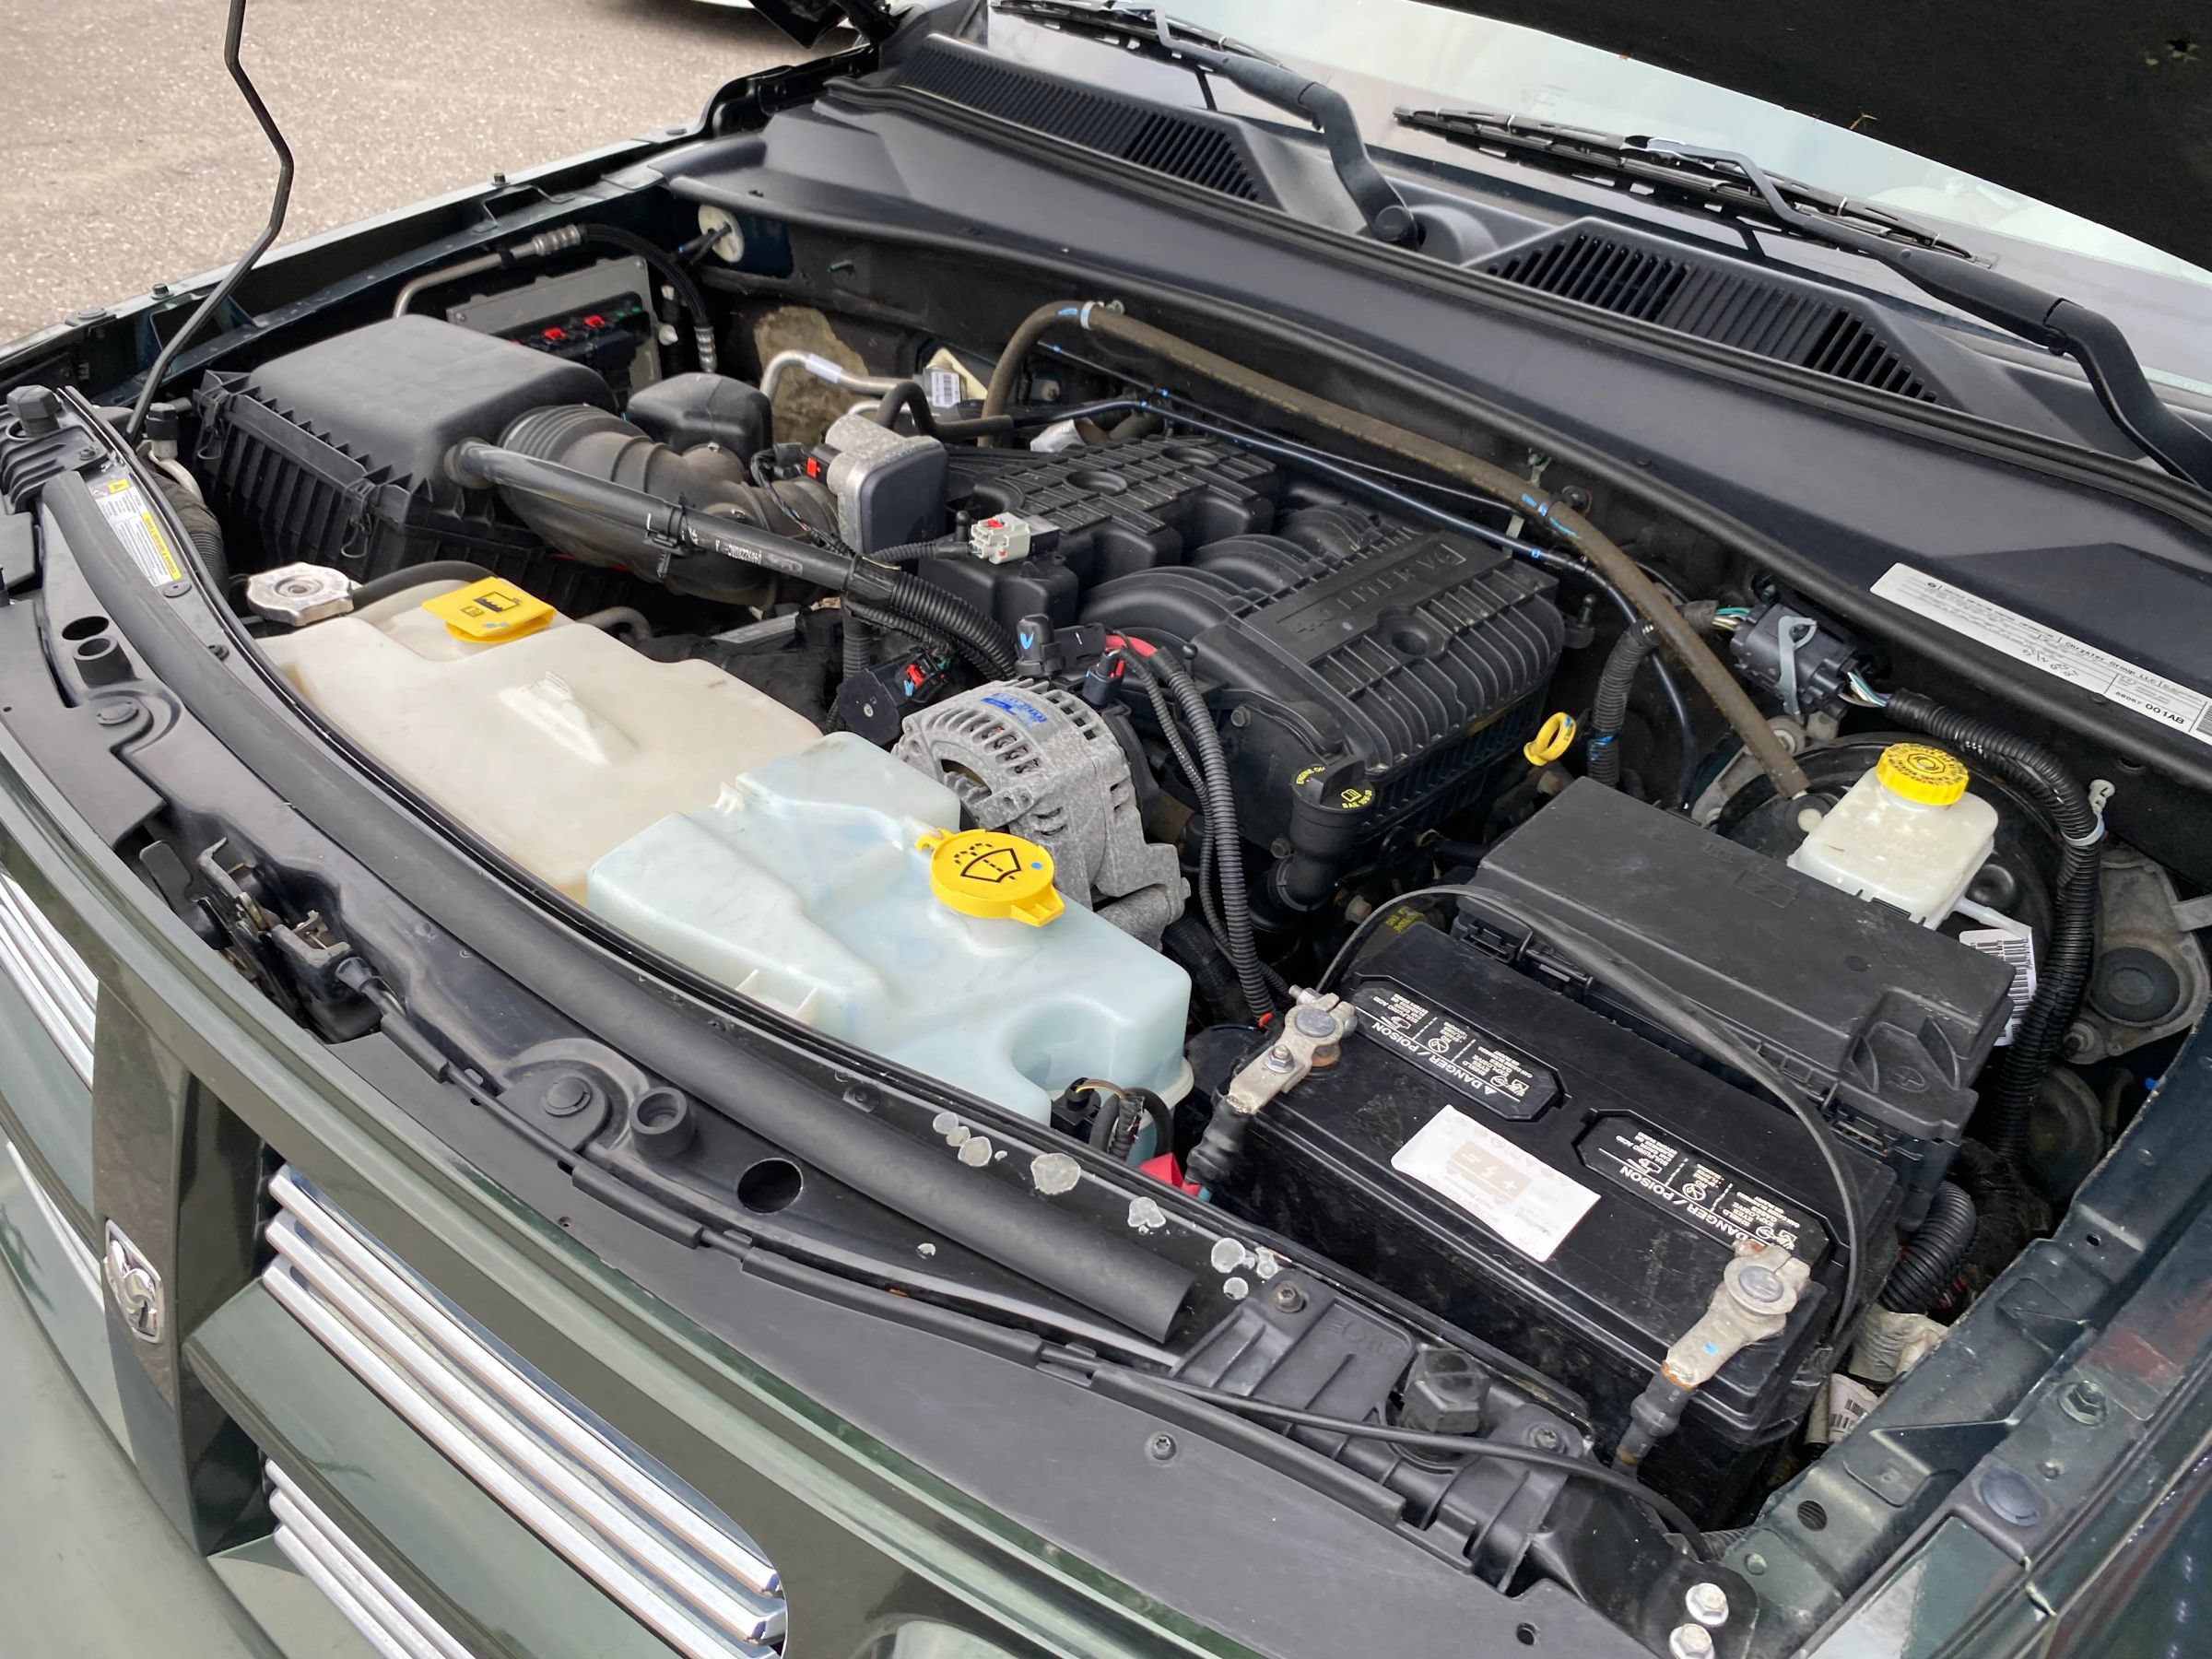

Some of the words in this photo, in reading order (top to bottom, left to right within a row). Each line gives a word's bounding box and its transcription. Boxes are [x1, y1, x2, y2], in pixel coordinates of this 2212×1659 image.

[2065, 641, 2105, 661] Chrysler
[2109, 661, 2136, 675] Group
[2145, 703, 2185, 724] 001AB
[1296, 769, 1314, 784] ENGINE
[1372, 996, 1388, 1006] ACID
[1387, 1005, 1418, 1023] SULFURIC
[1371, 1022, 1418, 1051] POISON
[1429, 1054, 1482, 1088] DANGER
[1472, 1054, 1509, 1077] EXPLOSIVE
[1489, 1058, 1512, 1073] GASES
[1616, 1135, 1633, 1147] ACID
[1632, 1145, 1668, 1166] SULFURIC
[1619, 1166, 1674, 1200] POISON
[1687, 1204, 1746, 1241] DANGER
[1732, 1202, 1774, 1227] EXPLOSIVE
[1750, 1206, 1777, 1222] GASES
